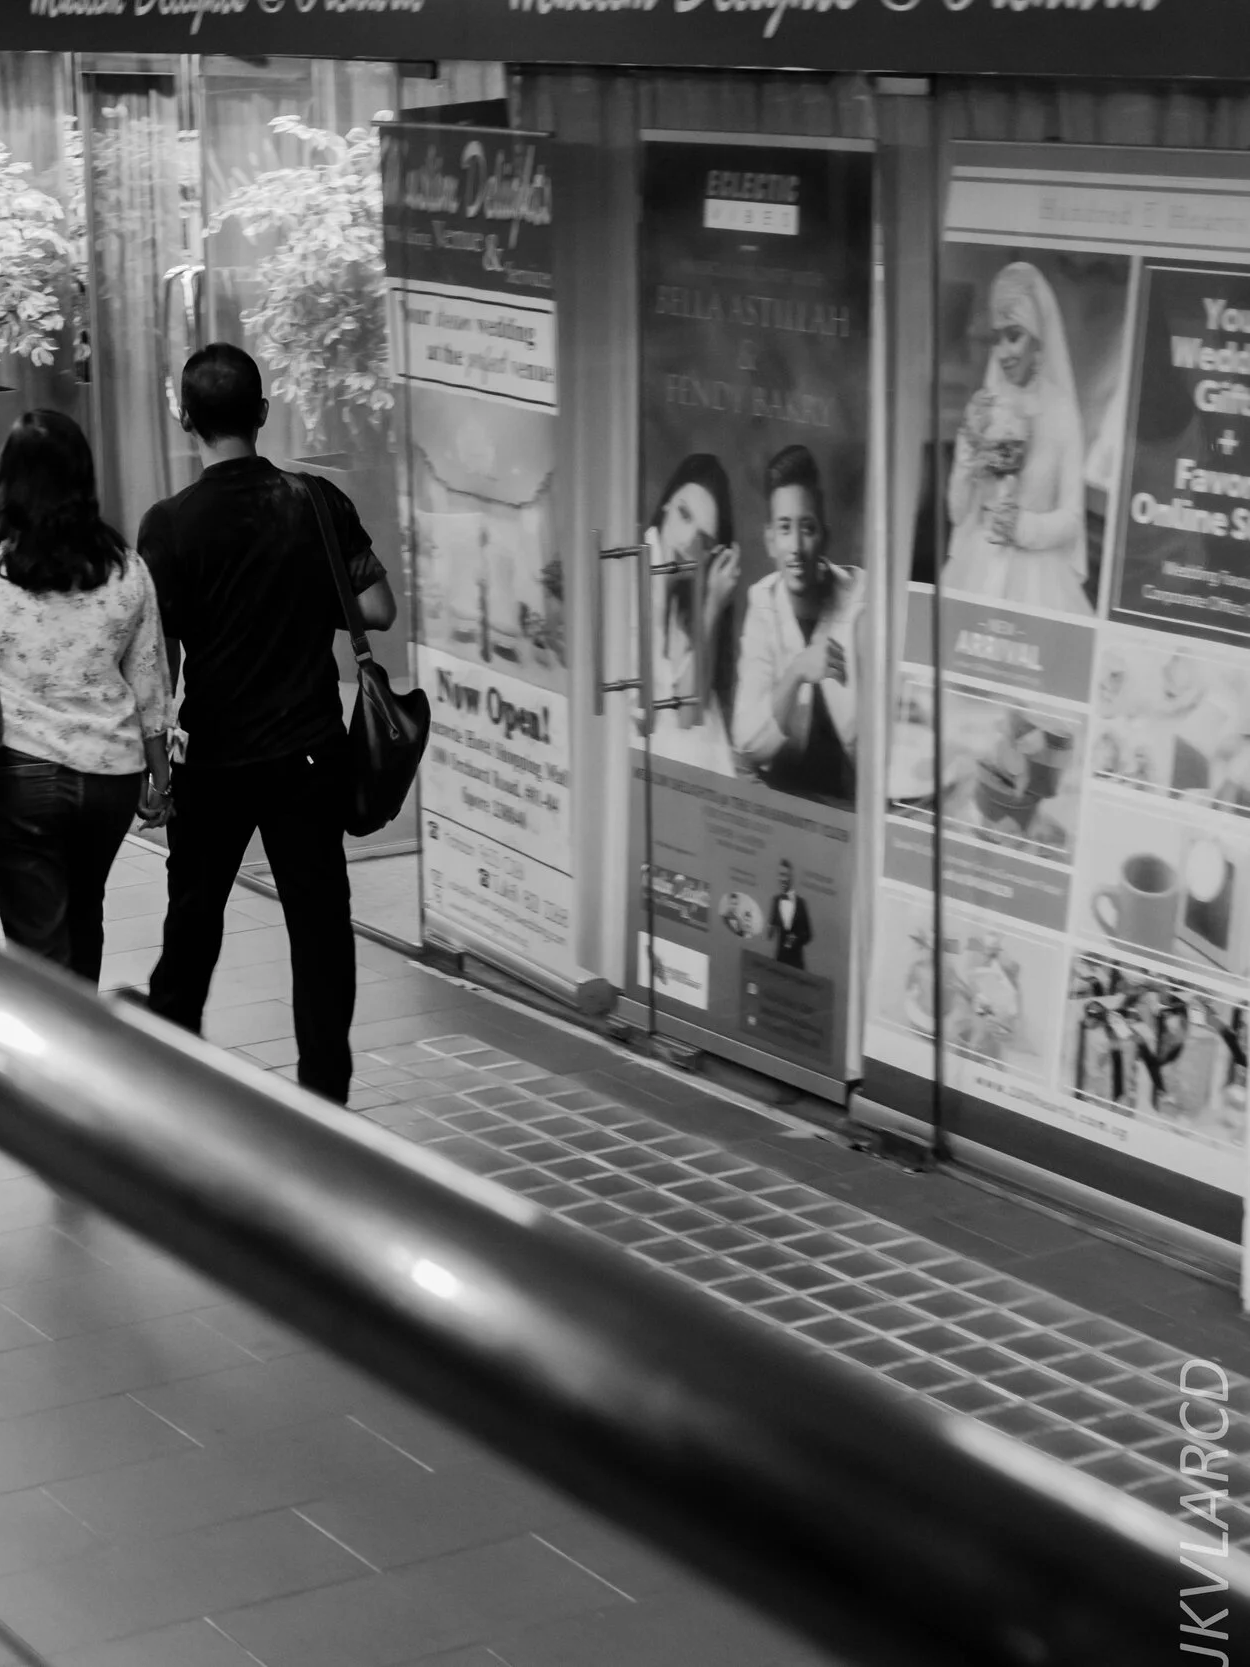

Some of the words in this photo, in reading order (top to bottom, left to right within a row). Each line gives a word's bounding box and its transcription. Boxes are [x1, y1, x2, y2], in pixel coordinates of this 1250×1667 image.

[1131, 492, 1229, 537] Online
[435, 667, 480, 714] Now
[486, 685, 551, 745] Open!
